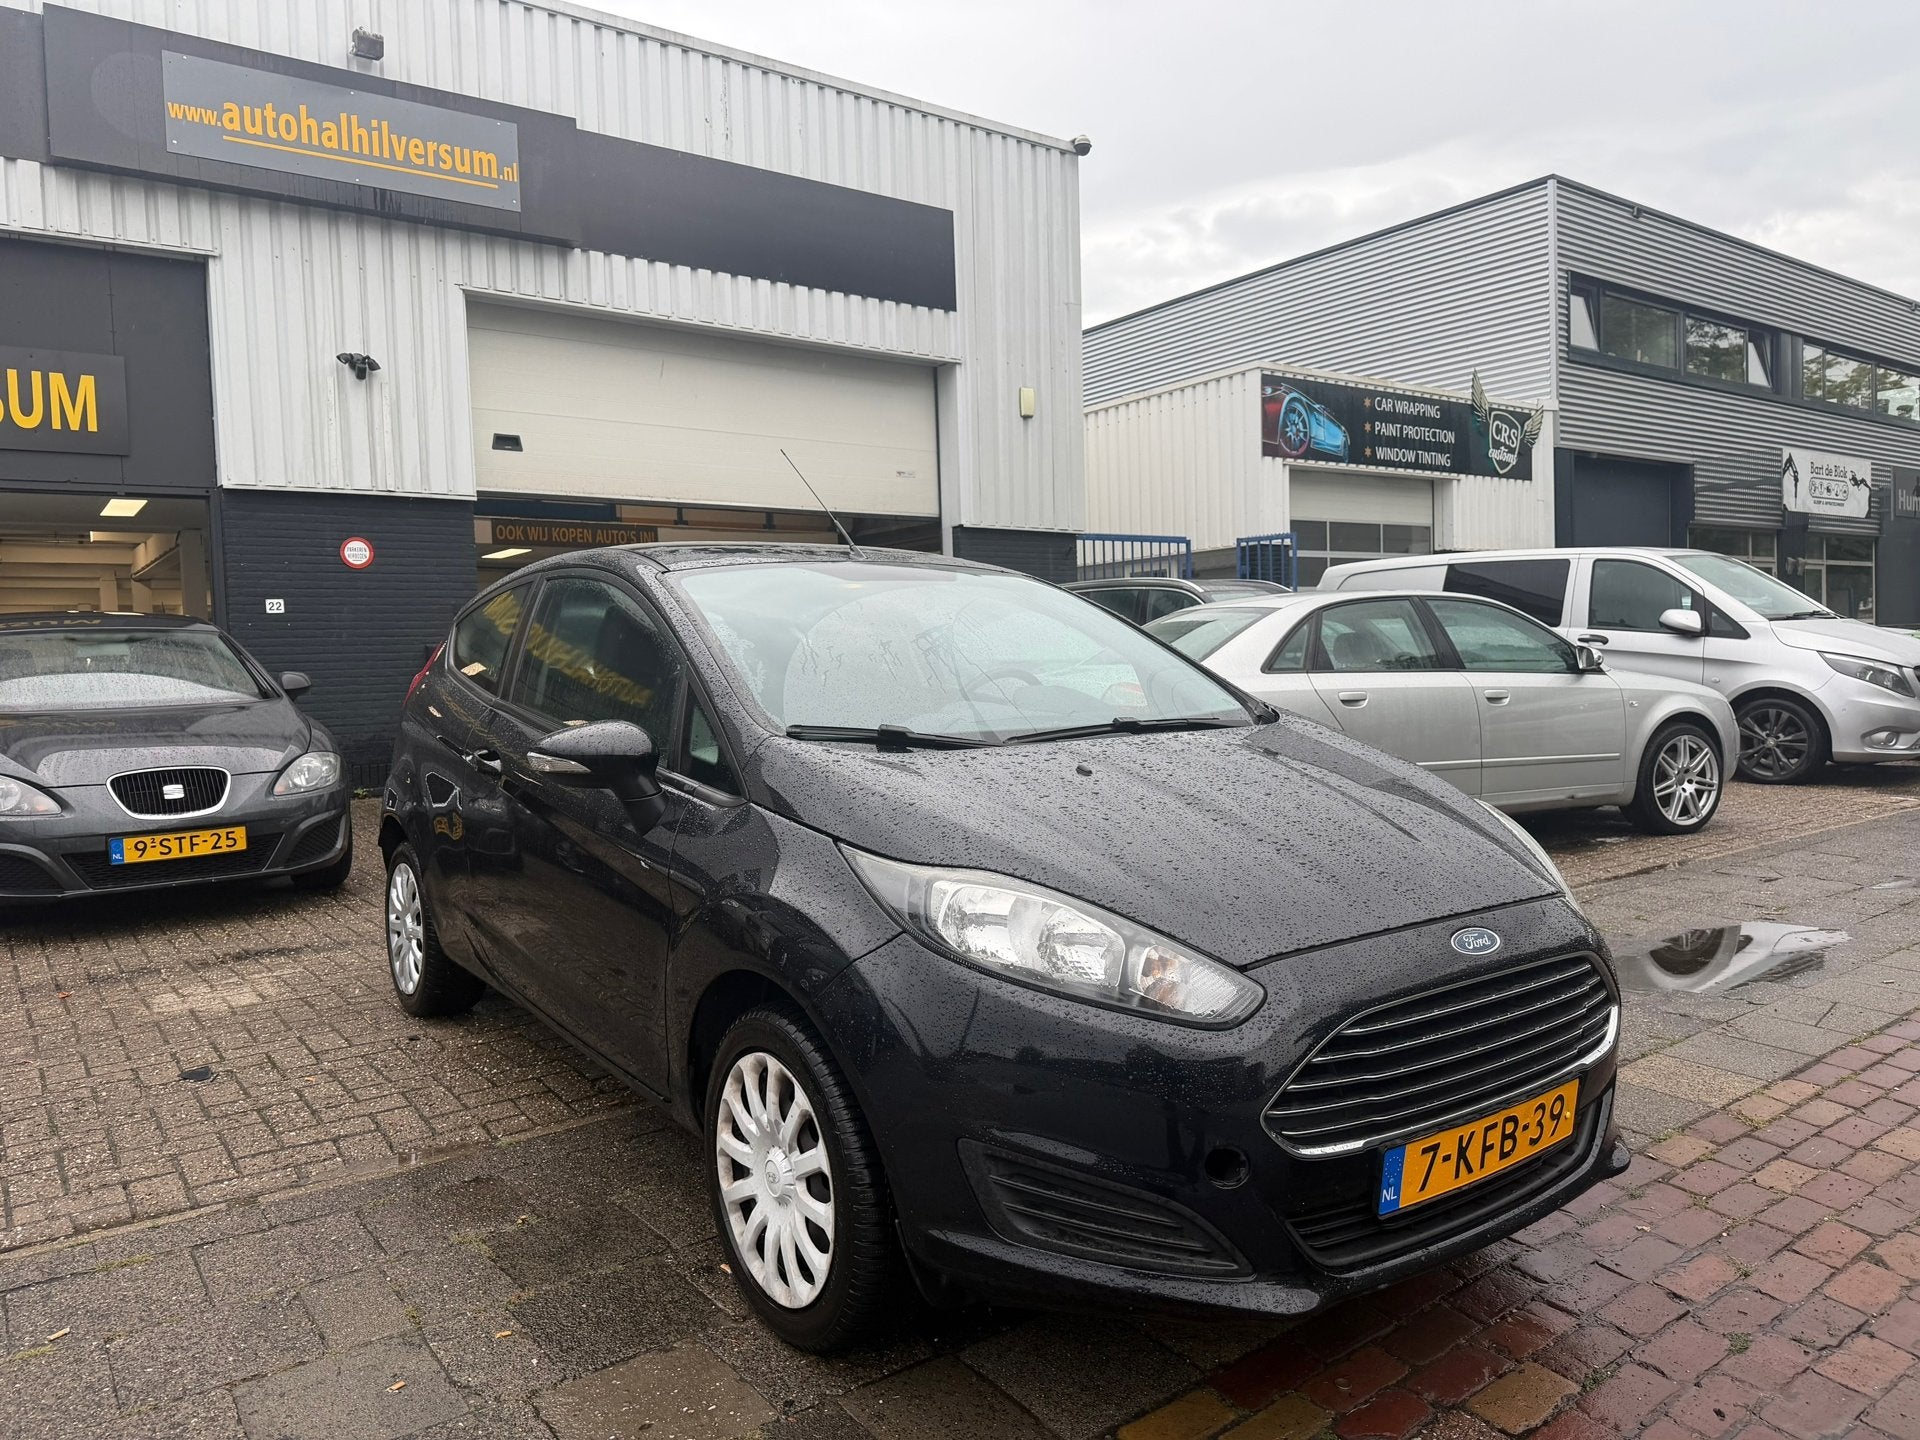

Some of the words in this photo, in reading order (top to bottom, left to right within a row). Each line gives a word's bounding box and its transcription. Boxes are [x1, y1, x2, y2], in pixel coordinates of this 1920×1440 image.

[167, 100, 518, 183] www.autohalhilversum.nl
[1374, 397, 1393, 412] CAR
[1394, 400, 1441, 419] WRAPPING
[1374, 421, 1401, 438] PAINT
[1402, 425, 1456, 444] PROTECTION
[1492, 420, 1518, 448] CRS
[1375, 446, 1416, 463] WINDOW
[1417, 450, 1451, 467] TINTING
[1488, 446, 1518, 465] customs
[1810, 461, 1824, 475] Bart
[1825, 464, 1833, 477] de
[496, 524, 525, 541] OOK
[527, 525, 549, 542] WIJ
[552, 527, 593, 544] KOPEN
[596, 528, 638, 545] AUTO'S
[268, 601, 282, 611] 22
[1463, 933, 1491, 949] Ford
[1381, 1186, 1398, 1203] NL
[1417, 1093, 1565, 1192] 7-KFB-39
